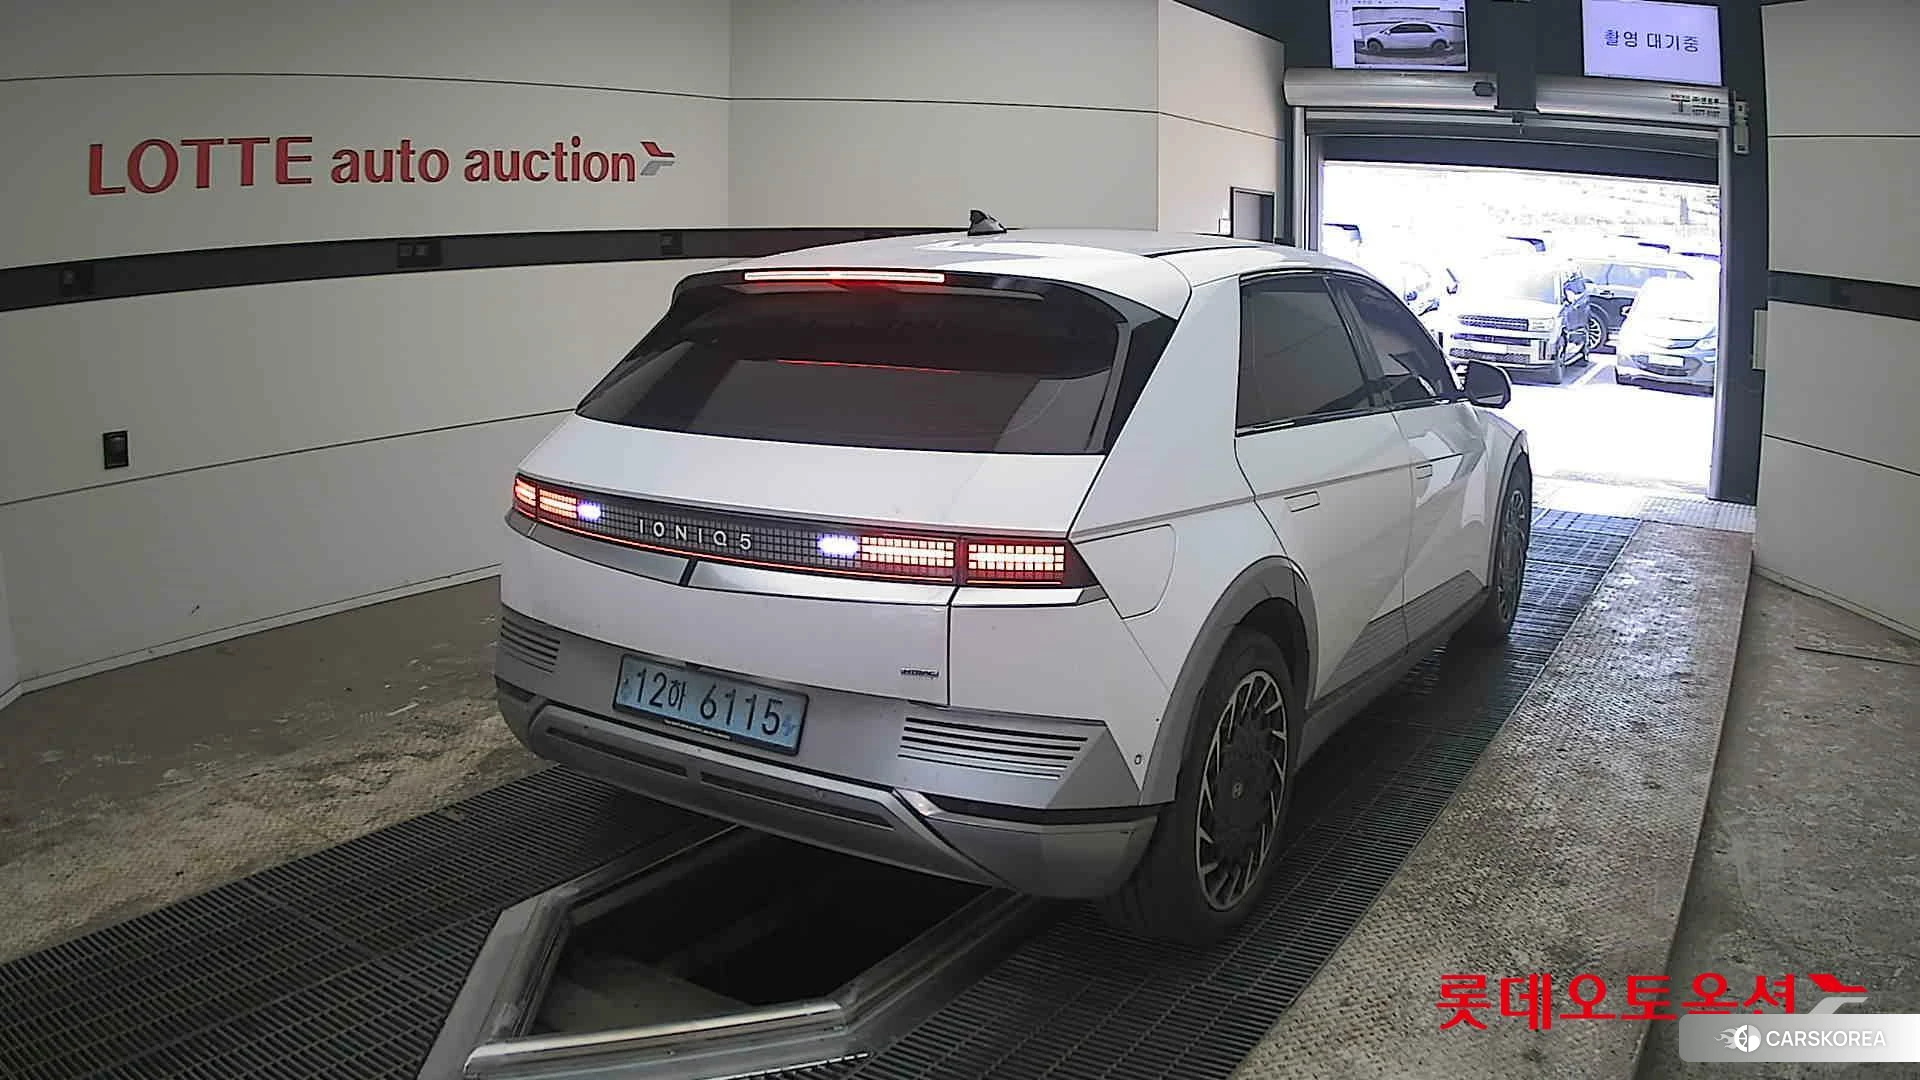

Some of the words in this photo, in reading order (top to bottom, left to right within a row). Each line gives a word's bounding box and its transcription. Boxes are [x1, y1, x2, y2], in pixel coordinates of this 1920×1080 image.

[1604, 29, 1638, 48] 촬영
[1646, 33, 1699, 53] 대기중
[88, 136, 313, 196] LOTTE
[330, 140, 449, 184] auto
[463, 136, 636, 184] auction
[638, 518, 728, 547] IONIQ
[739, 532, 752, 551] 5
[699, 684, 782, 736] 6115
